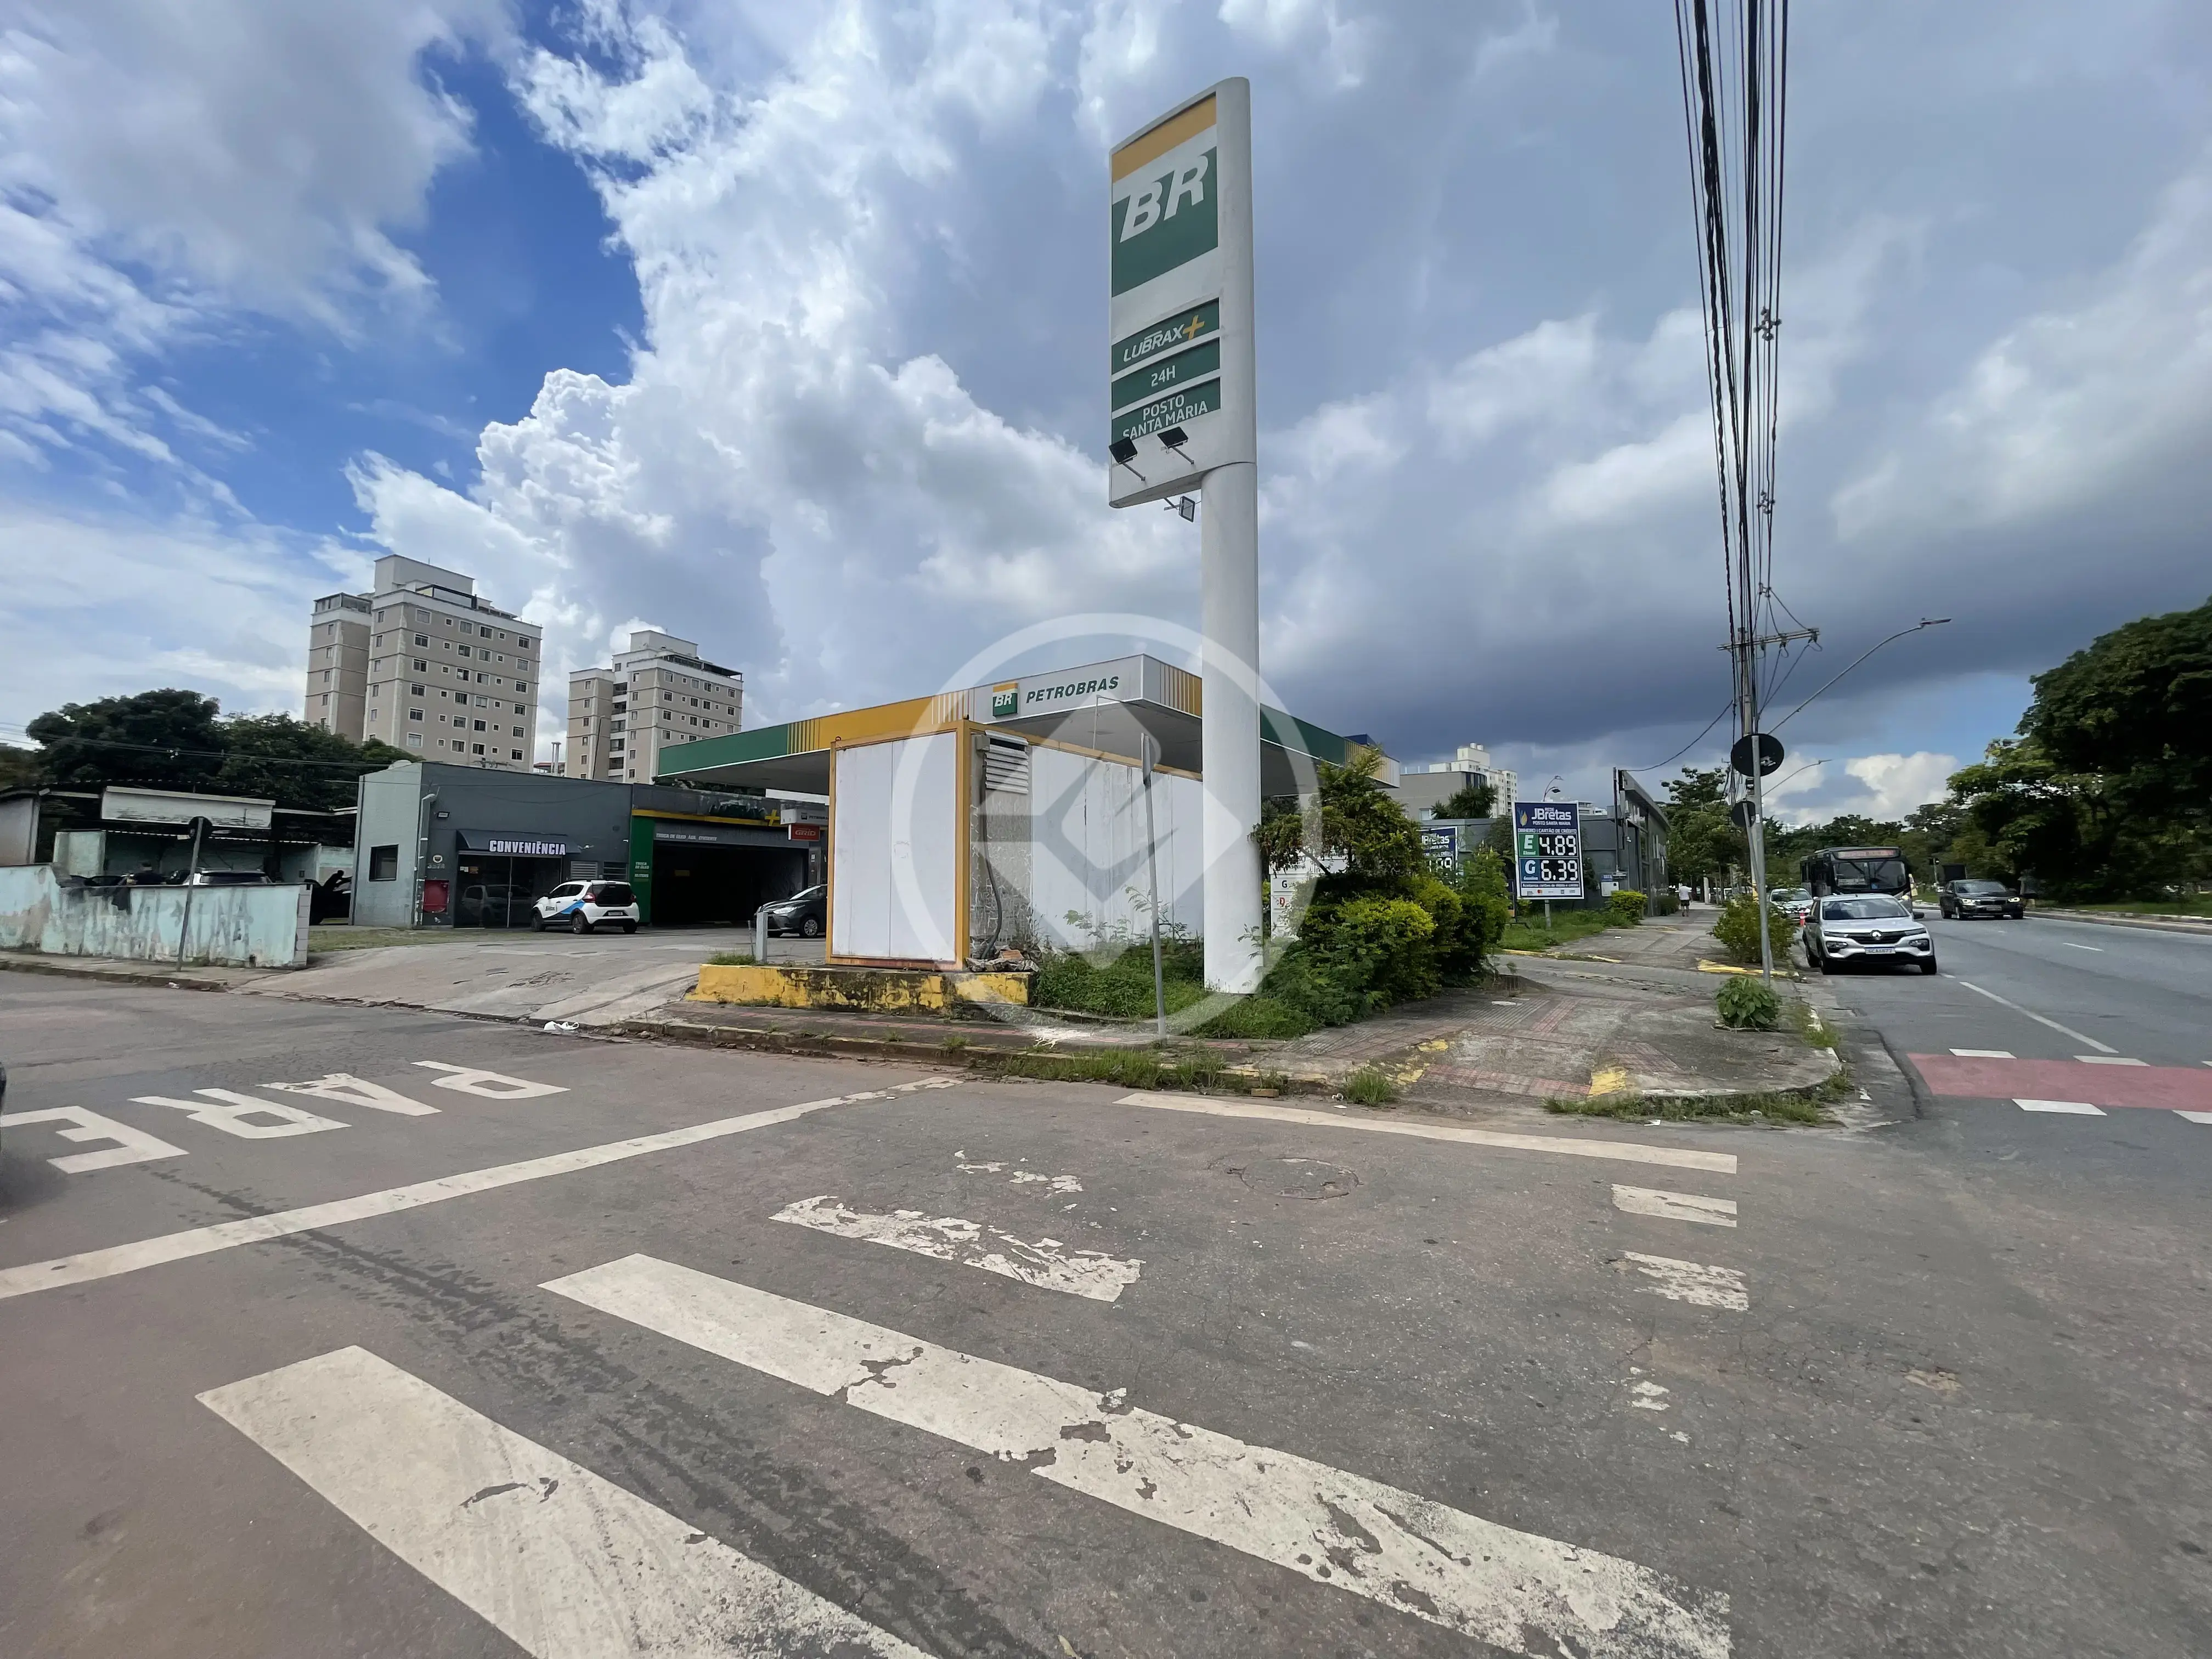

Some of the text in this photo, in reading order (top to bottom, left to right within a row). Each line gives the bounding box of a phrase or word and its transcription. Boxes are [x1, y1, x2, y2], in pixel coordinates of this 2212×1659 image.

[1120, 155, 1209, 243] BR
[1151, 365, 1176, 387] 24H
[1143, 394, 1185, 421] POSTO
[1122, 400, 1208, 439] SANTA MARIA
[994, 676, 1119, 707] BR PETROBRAS
[1531, 808, 1572, 820] JBretas
[489, 840, 566, 855] CONVENIÊNCIA
[1524, 835, 1534, 849] E
[1539, 835, 1577, 856] 4.89
[1525, 860, 1536, 874] G
[1541, 860, 1578, 881] 6.39
[0, 1060, 571, 1173] PARE
